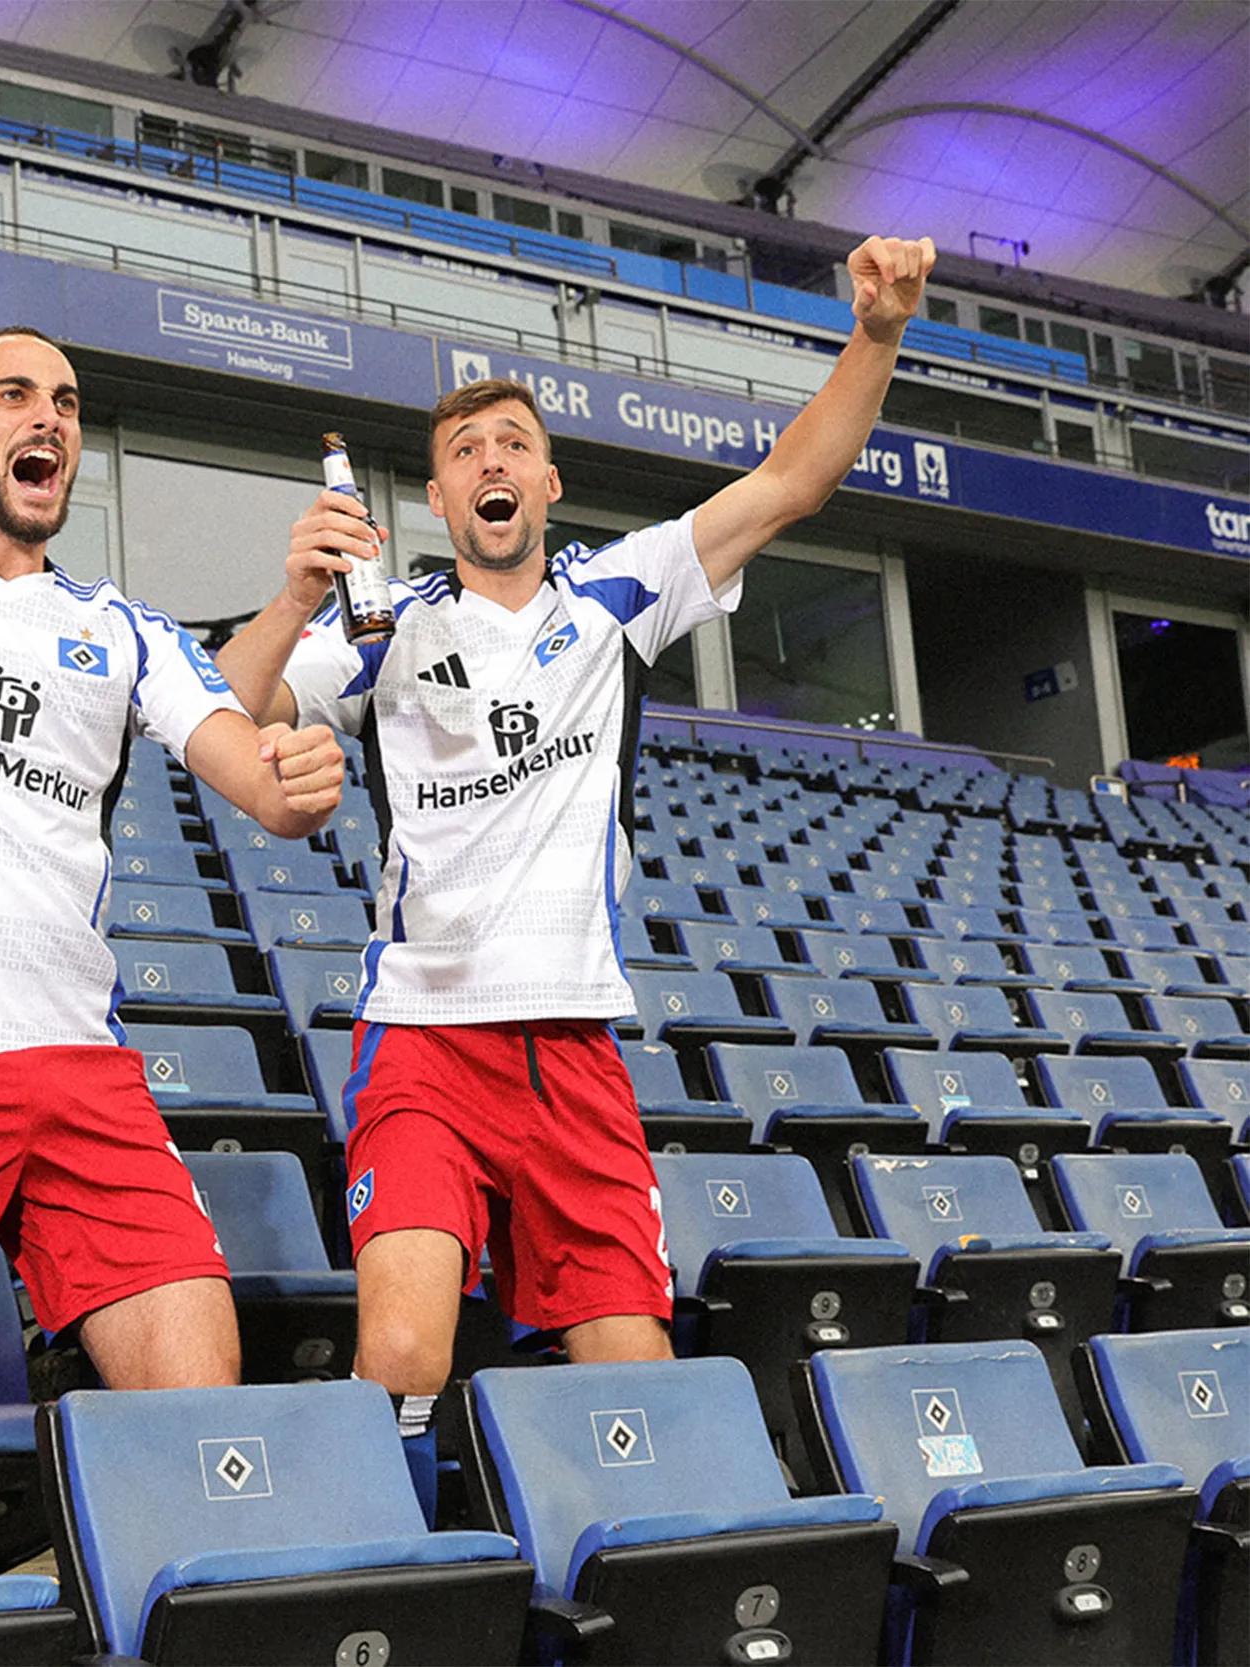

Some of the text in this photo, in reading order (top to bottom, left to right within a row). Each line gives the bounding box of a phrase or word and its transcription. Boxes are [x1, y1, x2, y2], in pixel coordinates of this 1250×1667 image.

[183, 303, 330, 350] Sparda-Bank
[226, 351, 294, 381] Hamburg
[617, 392, 745, 452] Gruppe
[753, 418, 903, 487] Hurg
[821, 1296, 831, 1314] 9
[1077, 1551, 1088, 1574] 8
[752, 1593, 764, 1617] 7
[356, 1641, 370, 1666] 6
